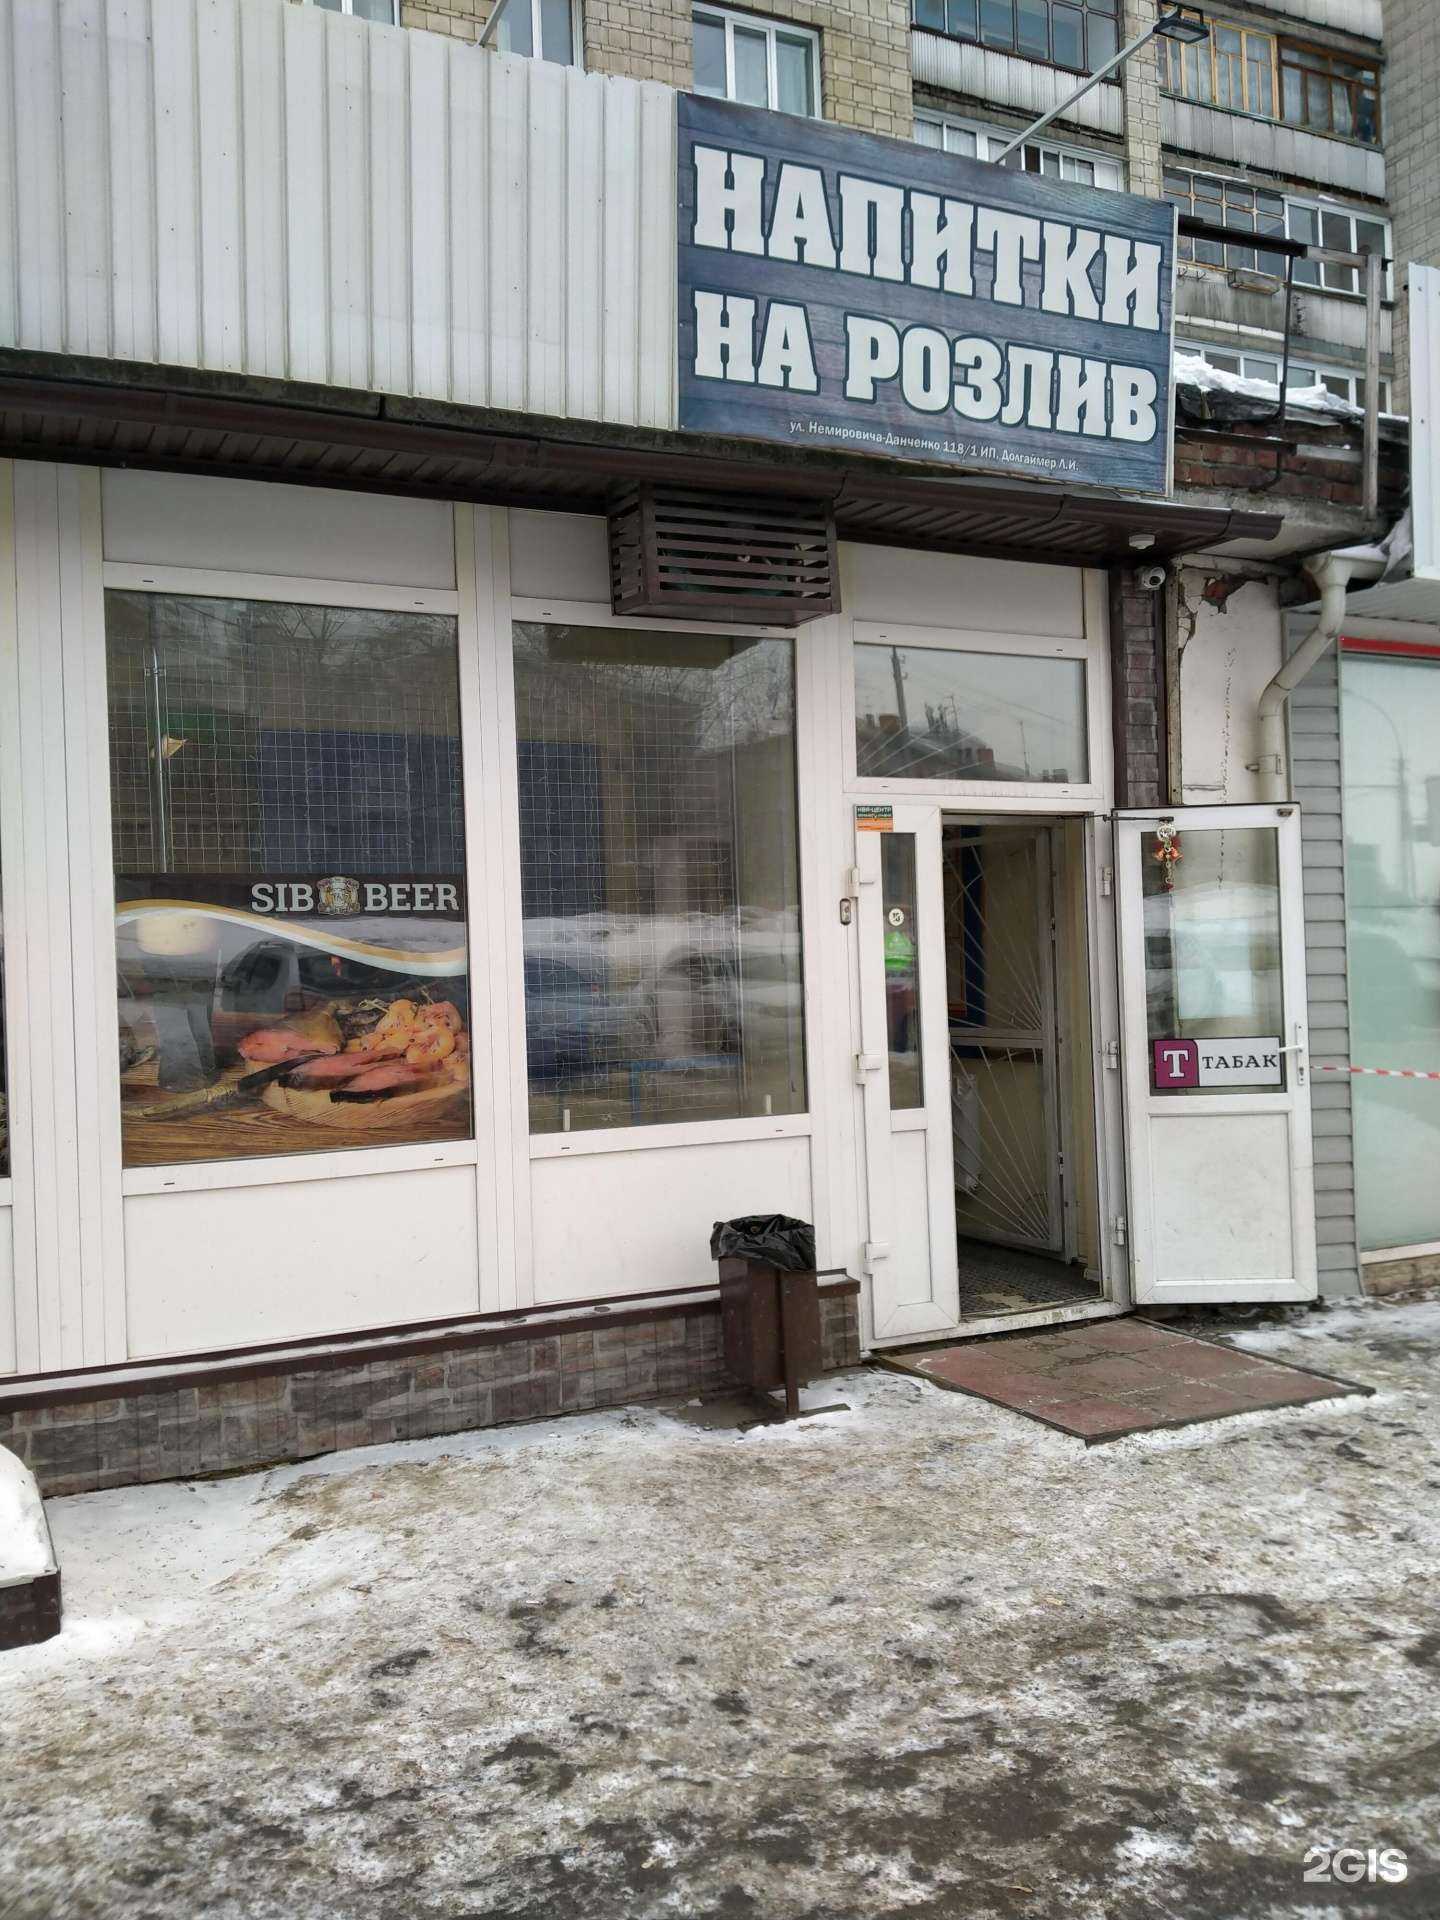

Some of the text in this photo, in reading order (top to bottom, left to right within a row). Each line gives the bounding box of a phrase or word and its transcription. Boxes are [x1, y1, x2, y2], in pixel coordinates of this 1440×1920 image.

[693, 144, 1163, 332] НАПИТКИ
[693, 290, 1159, 443] НА РОЗЛИВ
[790, 421, 805, 433] ул.
[808, 421, 940, 451] Немировича-Данченко
[943, 441, 978, 457] 118/1
[1058, 459, 1079, 471] Л.И.
[251, 883, 459, 912] SIB BEER
[1163, 1049, 1277, 1078] Т ТАБАК
